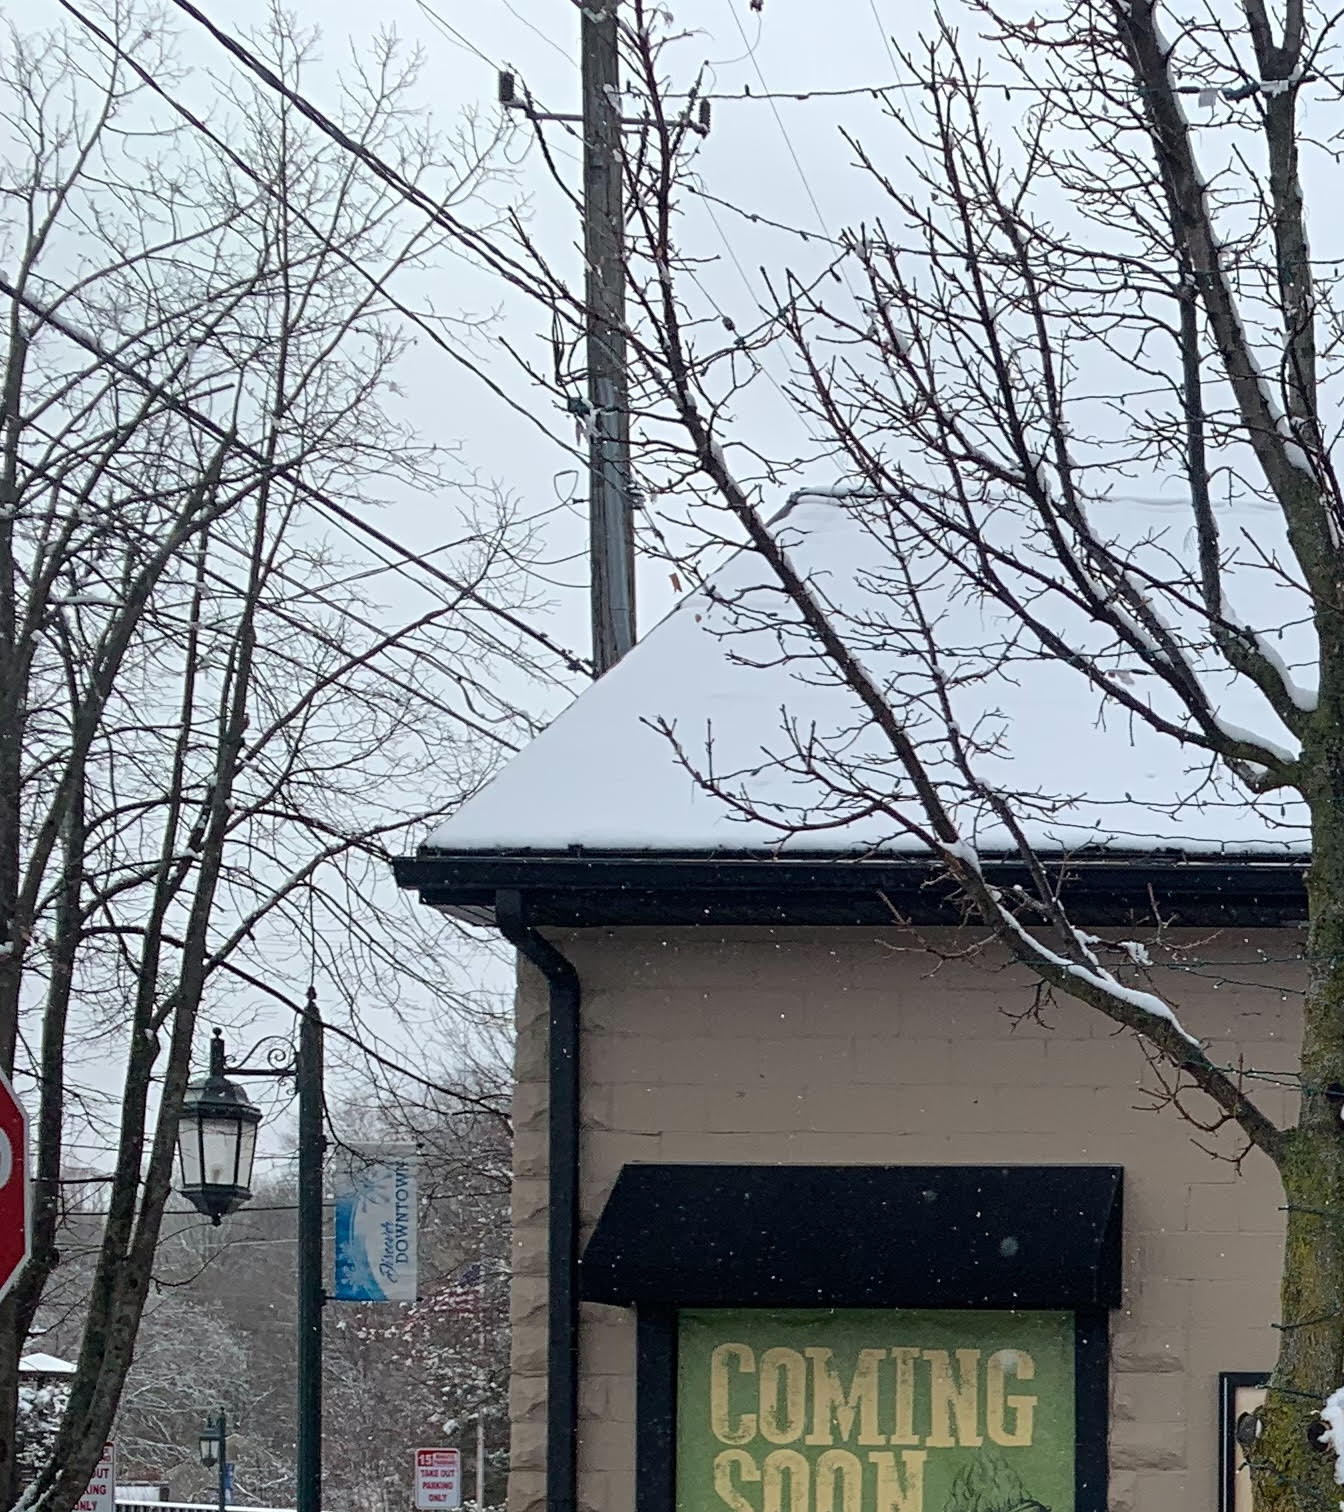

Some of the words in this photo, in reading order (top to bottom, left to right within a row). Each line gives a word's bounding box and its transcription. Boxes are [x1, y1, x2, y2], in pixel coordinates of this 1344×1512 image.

[395, 1161, 409, 1264] DOWNTOWN
[709, 1342, 1038, 1448] COMING
[92, 1468, 109, 1478] UT
[419, 1454, 432, 1465] 15
